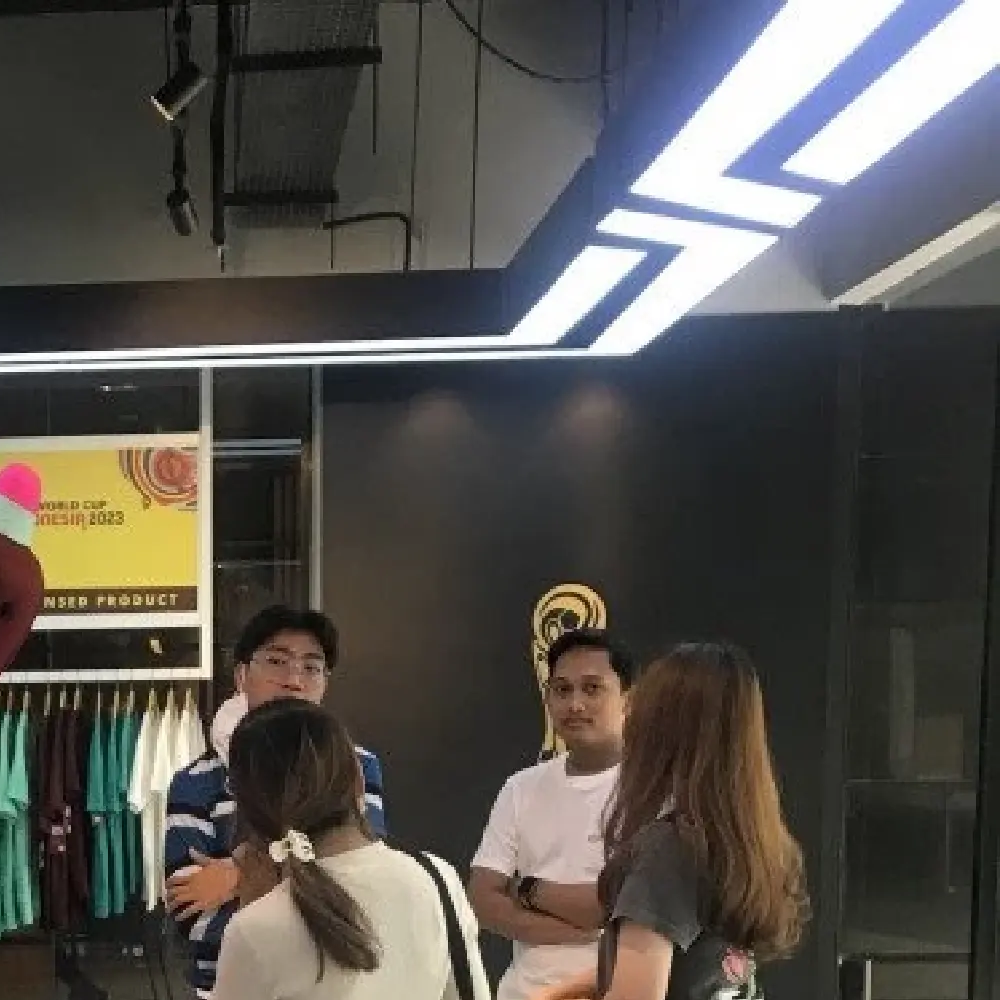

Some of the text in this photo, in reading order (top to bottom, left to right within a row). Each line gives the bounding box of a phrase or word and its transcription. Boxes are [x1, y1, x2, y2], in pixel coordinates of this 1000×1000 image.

[83, 500, 107, 510] CUP
[89, 510, 125, 526] 2023
[43, 593, 179, 609] NSED PRODUCT
